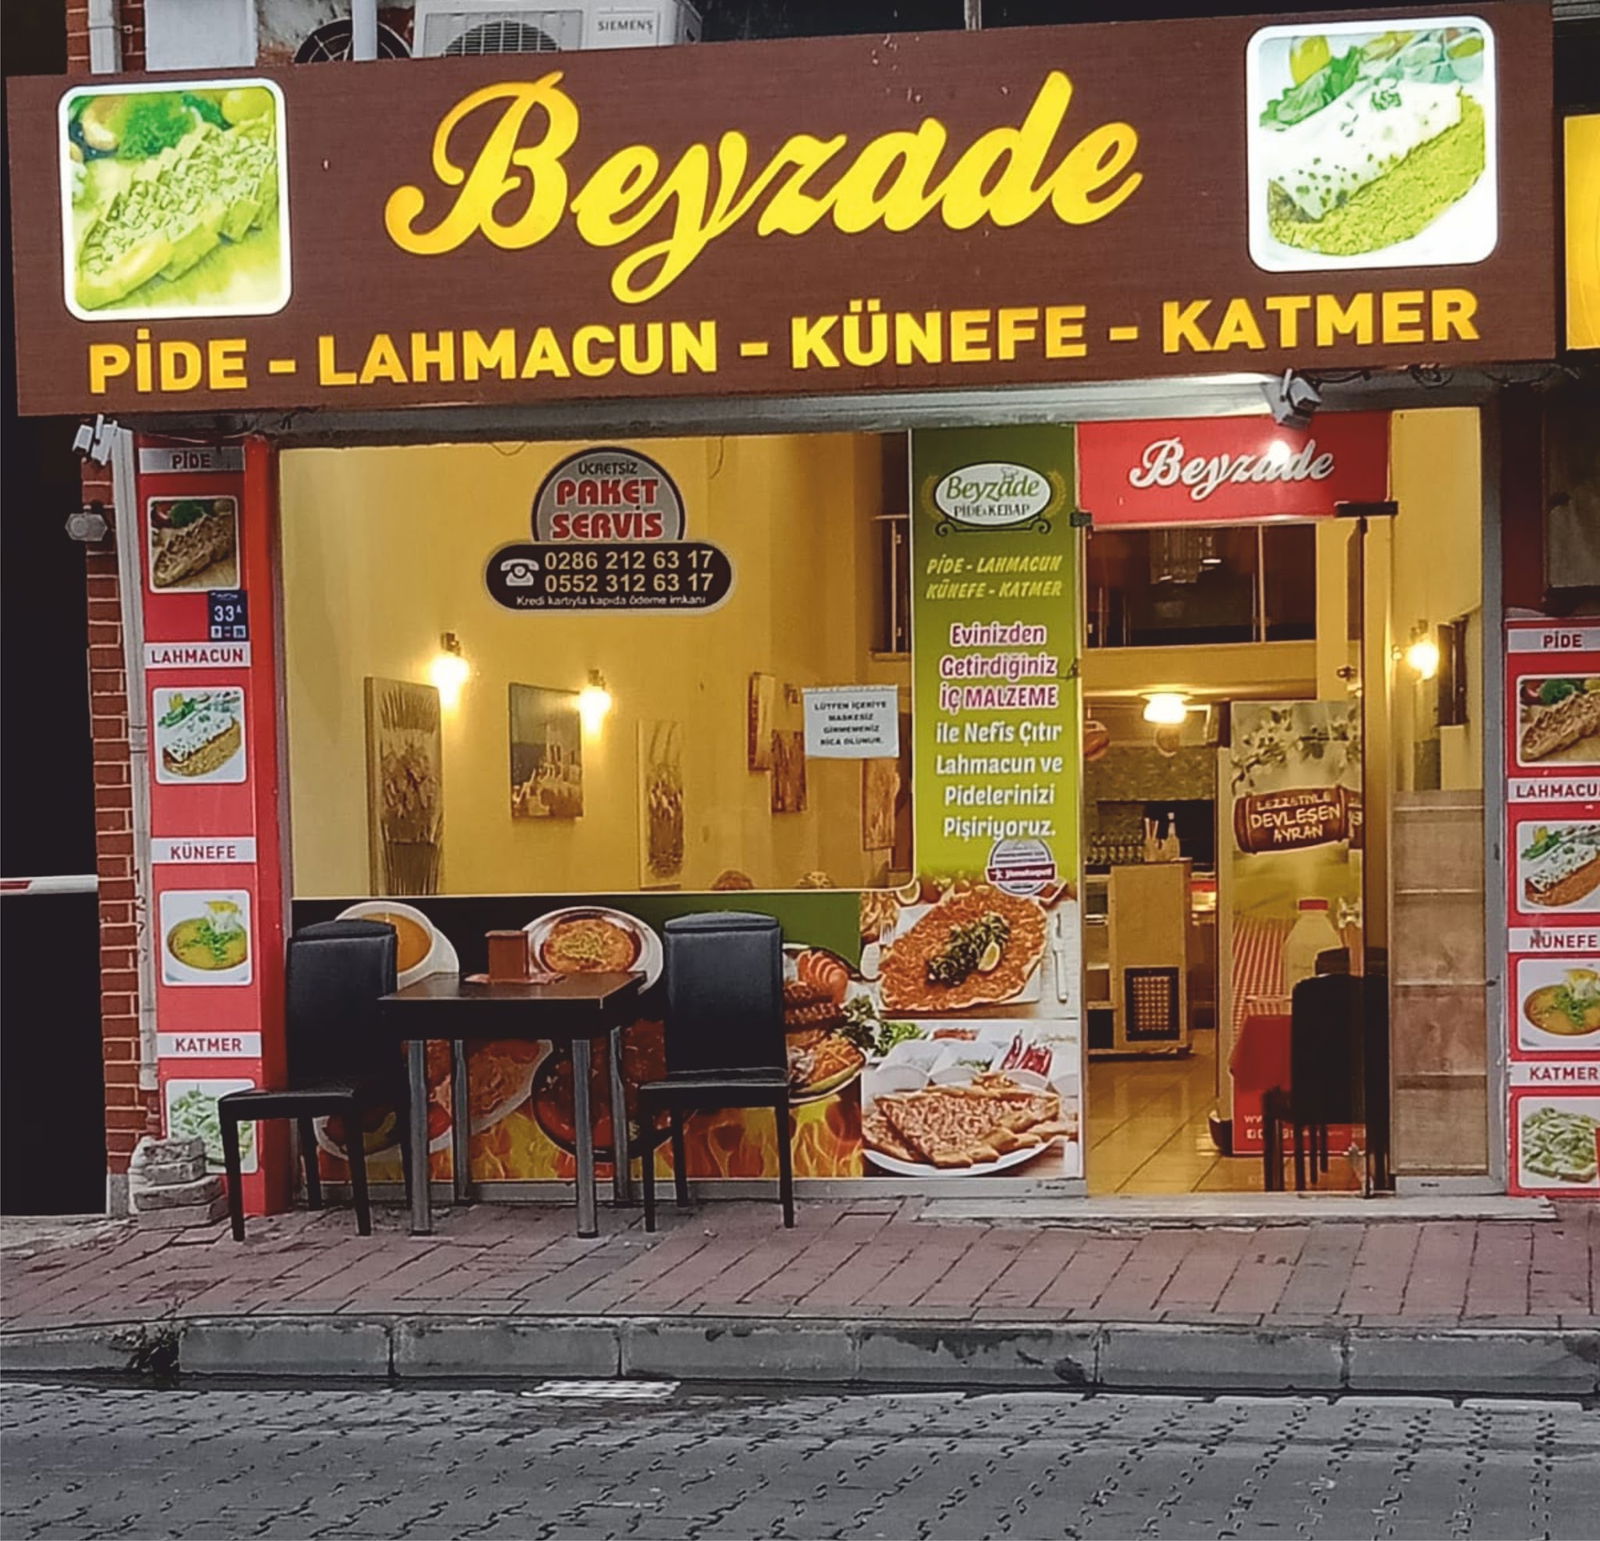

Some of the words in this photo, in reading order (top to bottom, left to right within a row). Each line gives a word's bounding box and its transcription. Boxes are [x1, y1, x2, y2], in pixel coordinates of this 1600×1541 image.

[597, 19, 653, 32] SIEMENS
[384, 70, 1143, 304] Beyzade
[89, 329, 249, 394] PİDE
[318, 320, 718, 387] LAHMACUN
[791, 299, 1088, 369] KÜNEFE
[1162, 288, 1480, 355] KATMER
[171, 450, 212, 470] PİDE
[578, 461, 639, 475] ÜCRETSİZ
[1129, 436, 1336, 502] Beyzade
[555, 478, 660, 506] PAKET
[945, 475, 1040, 505] Beyzade
[551, 505, 664, 540] SERVİS
[544, 551, 599, 570] 0286
[605, 551, 646, 569] 212
[652, 551, 680, 569] 63
[687, 550, 714, 568] 17
[926, 553, 965, 575] PİDE
[976, 554, 1064, 574] LAHMACUN
[544, 573, 599, 593] 0552
[605, 573, 646, 592] 312
[652, 573, 680, 592] 63
[687, 572, 714, 592] 17
[926, 578, 987, 600] KÜNEFE
[998, 580, 1063, 598] KATMER
[516, 595, 545, 606] Kredi
[629, 594, 666, 605] ödeme
[951, 623, 1046, 645] Evinizden
[1542, 630, 1583, 648] PİDE
[151, 649, 244, 664] LAHMACUN
[941, 655, 1056, 680] Getirdiğiniz
[814, 701, 849, 711] LÜTFEN
[941, 683, 964, 713] İÇ
[965, 685, 1057, 709] MALZEME
[936, 722, 959, 743] ile
[964, 722, 1015, 743] Nefis
[1019, 720, 1063, 747] Çıtır
[936, 754, 1036, 776] Lahmacun
[1040, 756, 1063, 773] ve
[944, 783, 1055, 807] Pidelerinizi
[1516, 783, 1600, 799] LAHMACU
[1250, 803, 1340, 828] DEVLEŞEN
[943, 815, 1056, 841] Pişiriyoruz.
[1273, 823, 1323, 843] AYRAN
[170, 842, 237, 860] KÜNEFE
[174, 1037, 242, 1052] KATMER
[1529, 1066, 1598, 1081] KATMER
